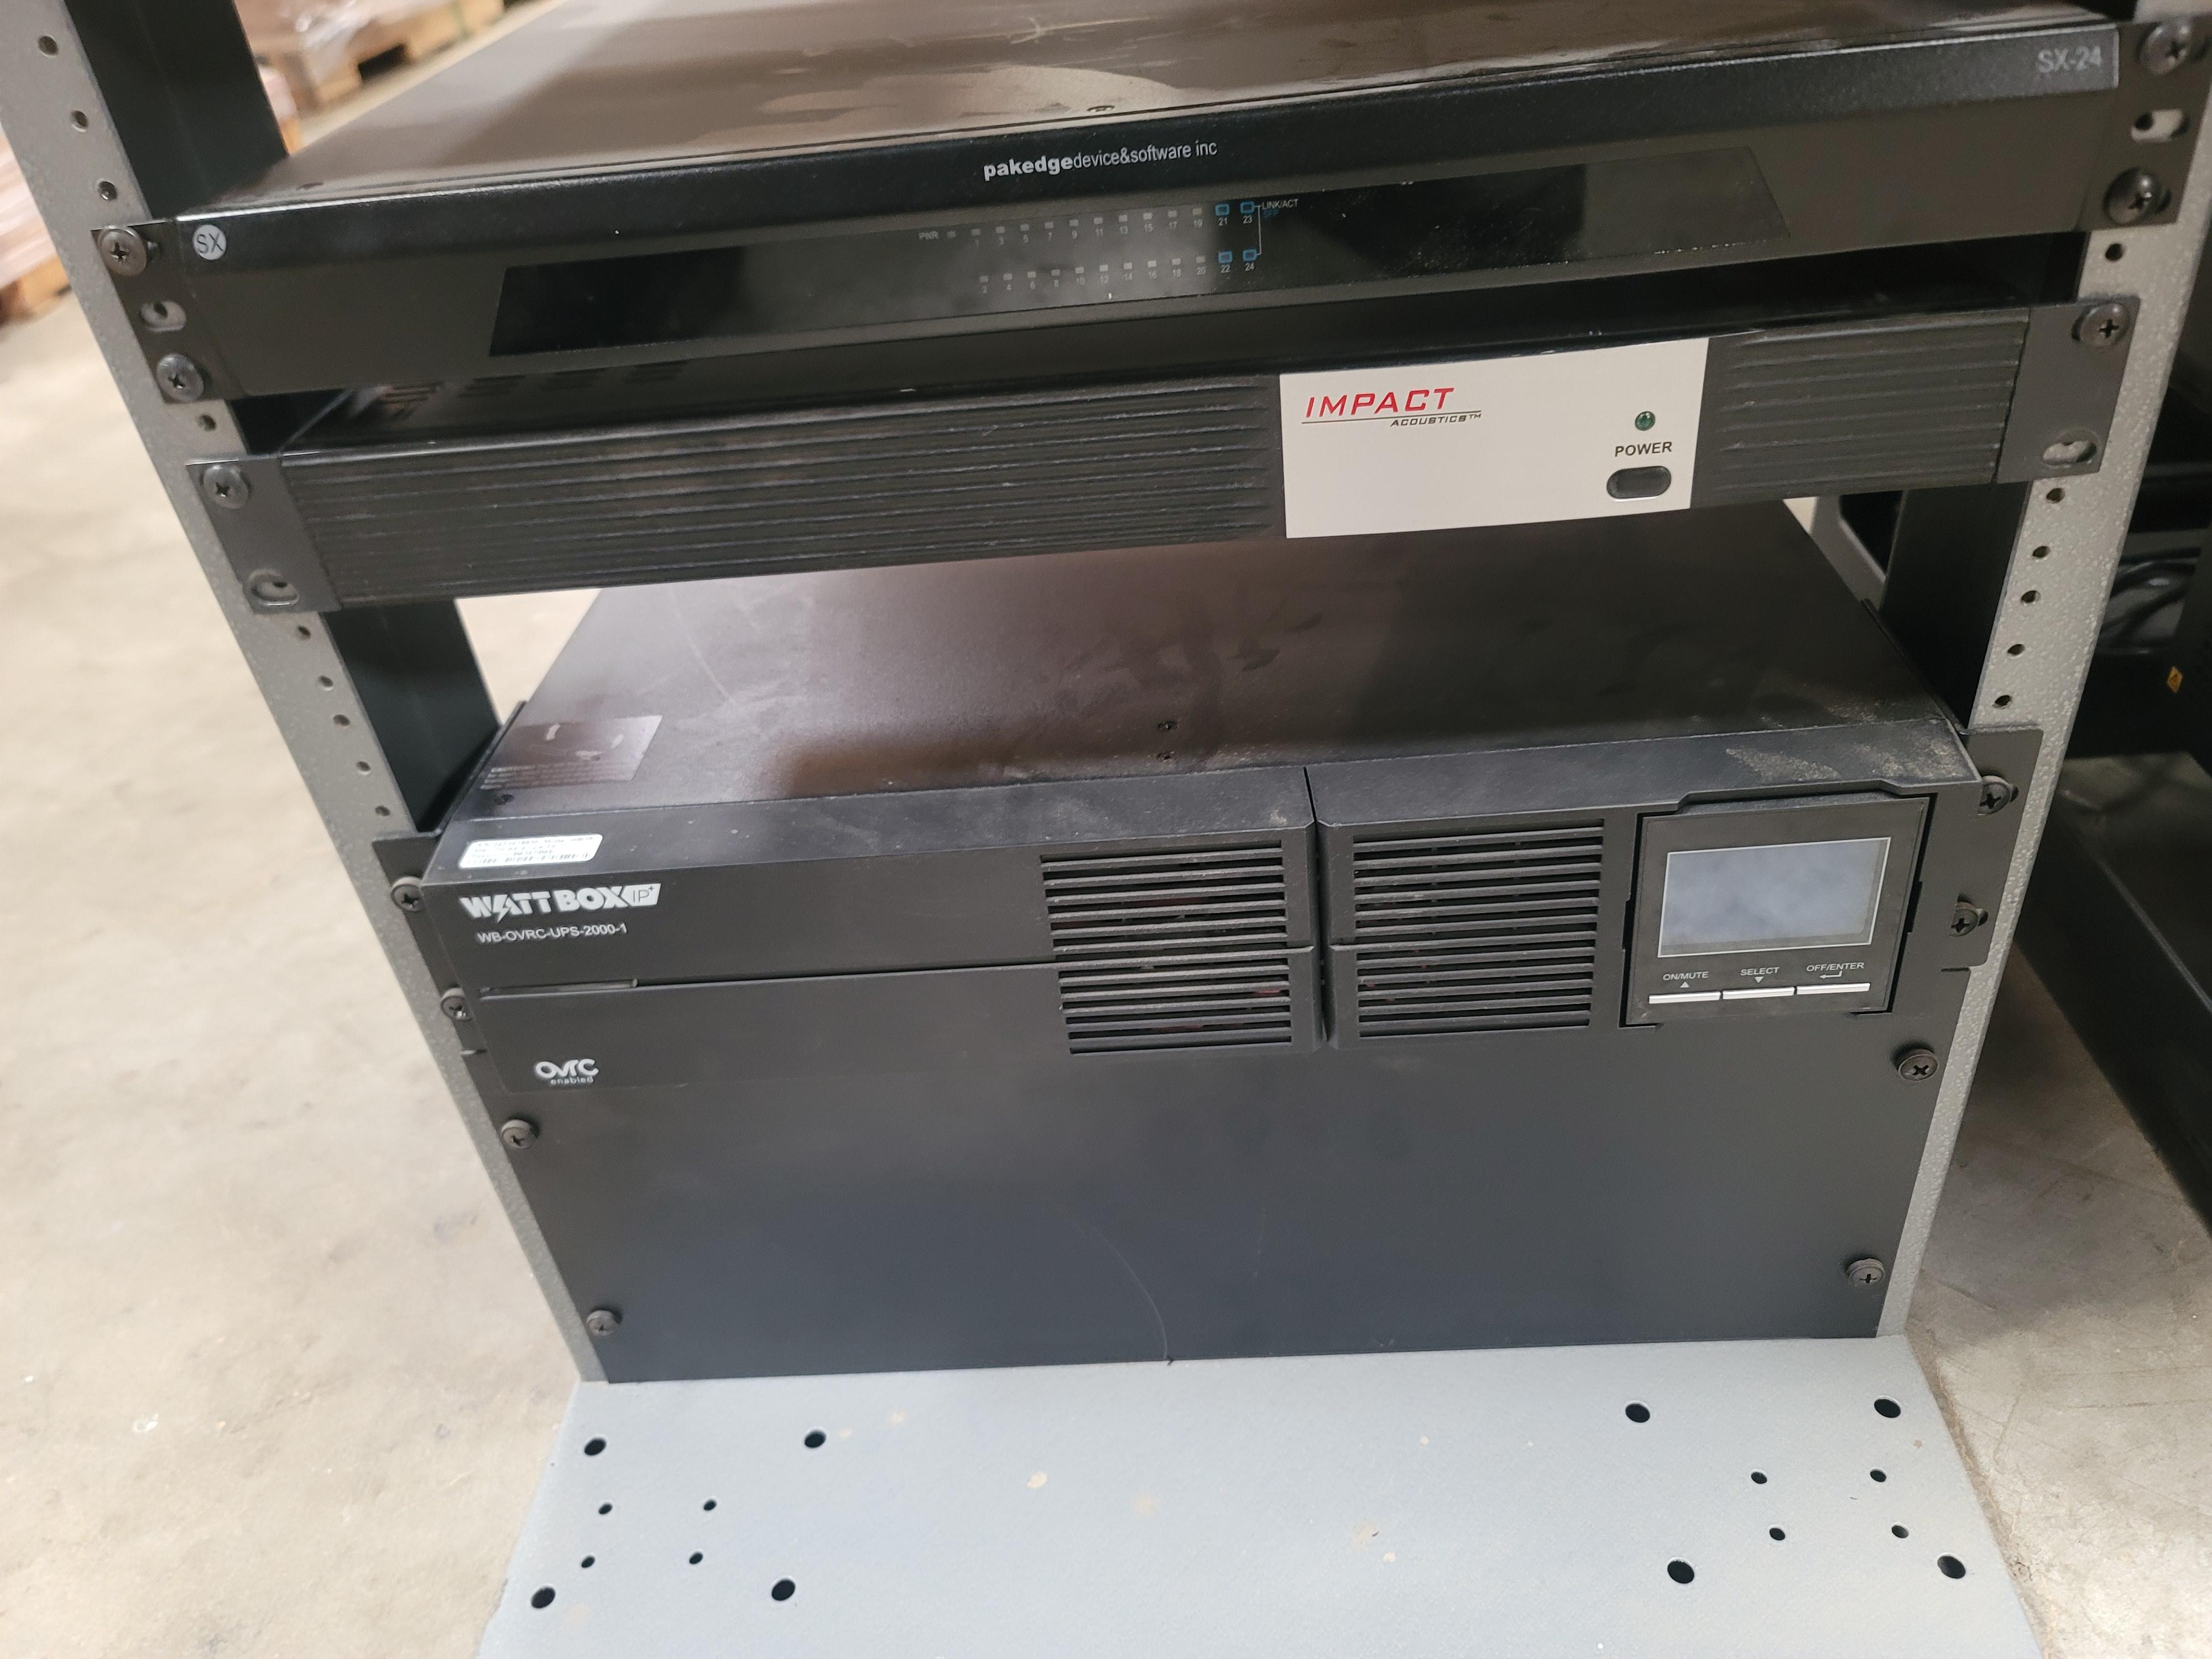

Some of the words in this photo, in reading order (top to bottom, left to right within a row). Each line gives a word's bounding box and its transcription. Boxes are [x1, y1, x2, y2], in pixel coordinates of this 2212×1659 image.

[2038, 45, 2101, 73] SX-24
[1195, 140, 1218, 156] inc
[1261, 199, 1298, 210] LINK/ACT
[1072, 230, 1077, 239] 9
[1144, 224, 1153, 232] 15
[1243, 216, 1252, 224] 23
[196, 232, 224, 254] SX
[1100, 275, 1109, 284] 12
[1148, 270, 1157, 279] 16
[1196, 267, 1206, 275] 20
[1306, 388, 1454, 418] IMPACT
[1614, 441, 1672, 457] POWER
[460, 891, 551, 922] WATT
[552, 886, 629, 911] BOX
[477, 922, 628, 943] WB-OVRC-UPS-2000-1
[1740, 966, 1780, 977] SELECT
[1806, 962, 1864, 972] OFF/ENTER
[1663, 971, 1709, 981] ON/MUTE
[550, 1076, 593, 1085] enabled
